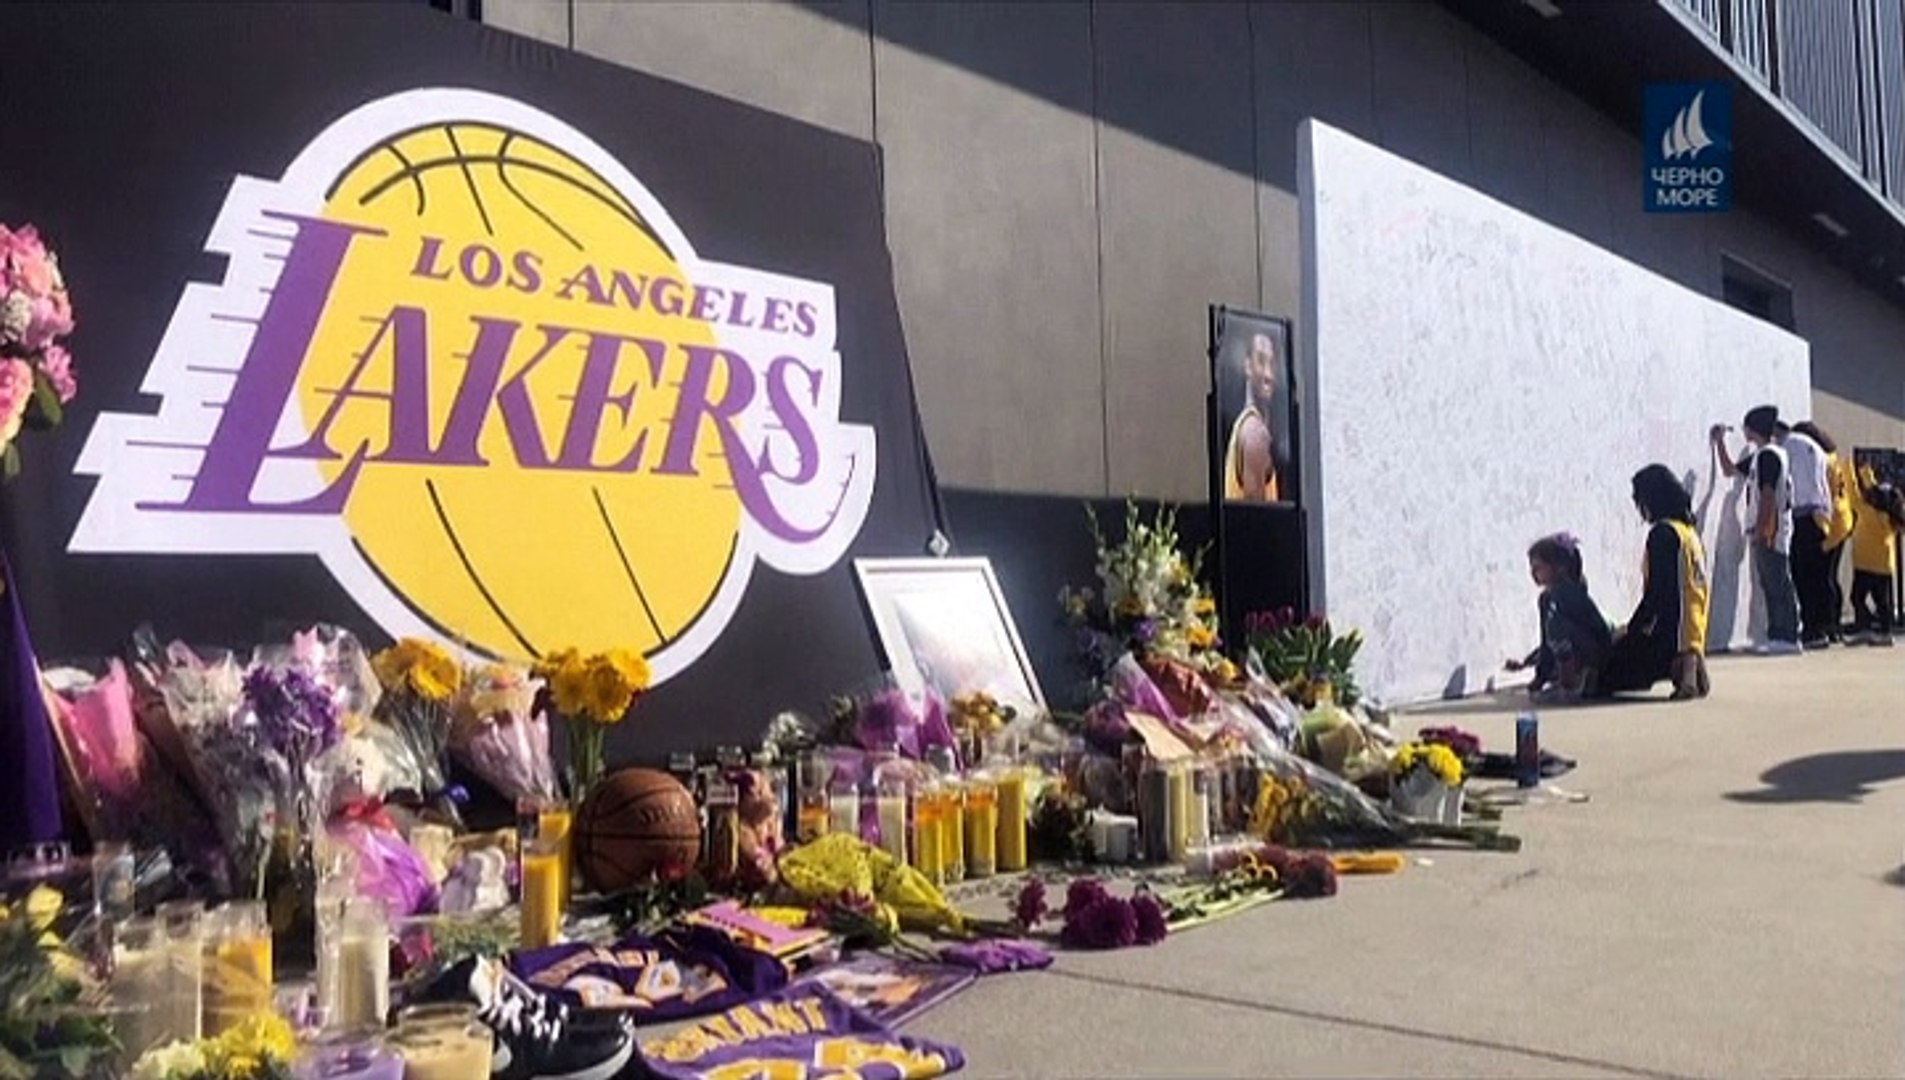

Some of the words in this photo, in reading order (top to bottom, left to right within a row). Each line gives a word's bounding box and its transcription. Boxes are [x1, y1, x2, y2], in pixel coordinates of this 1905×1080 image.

[134, 210, 856, 543] LAKERS
[411, 237, 542, 293] LOS
[555, 263, 818, 337] ANGELES
